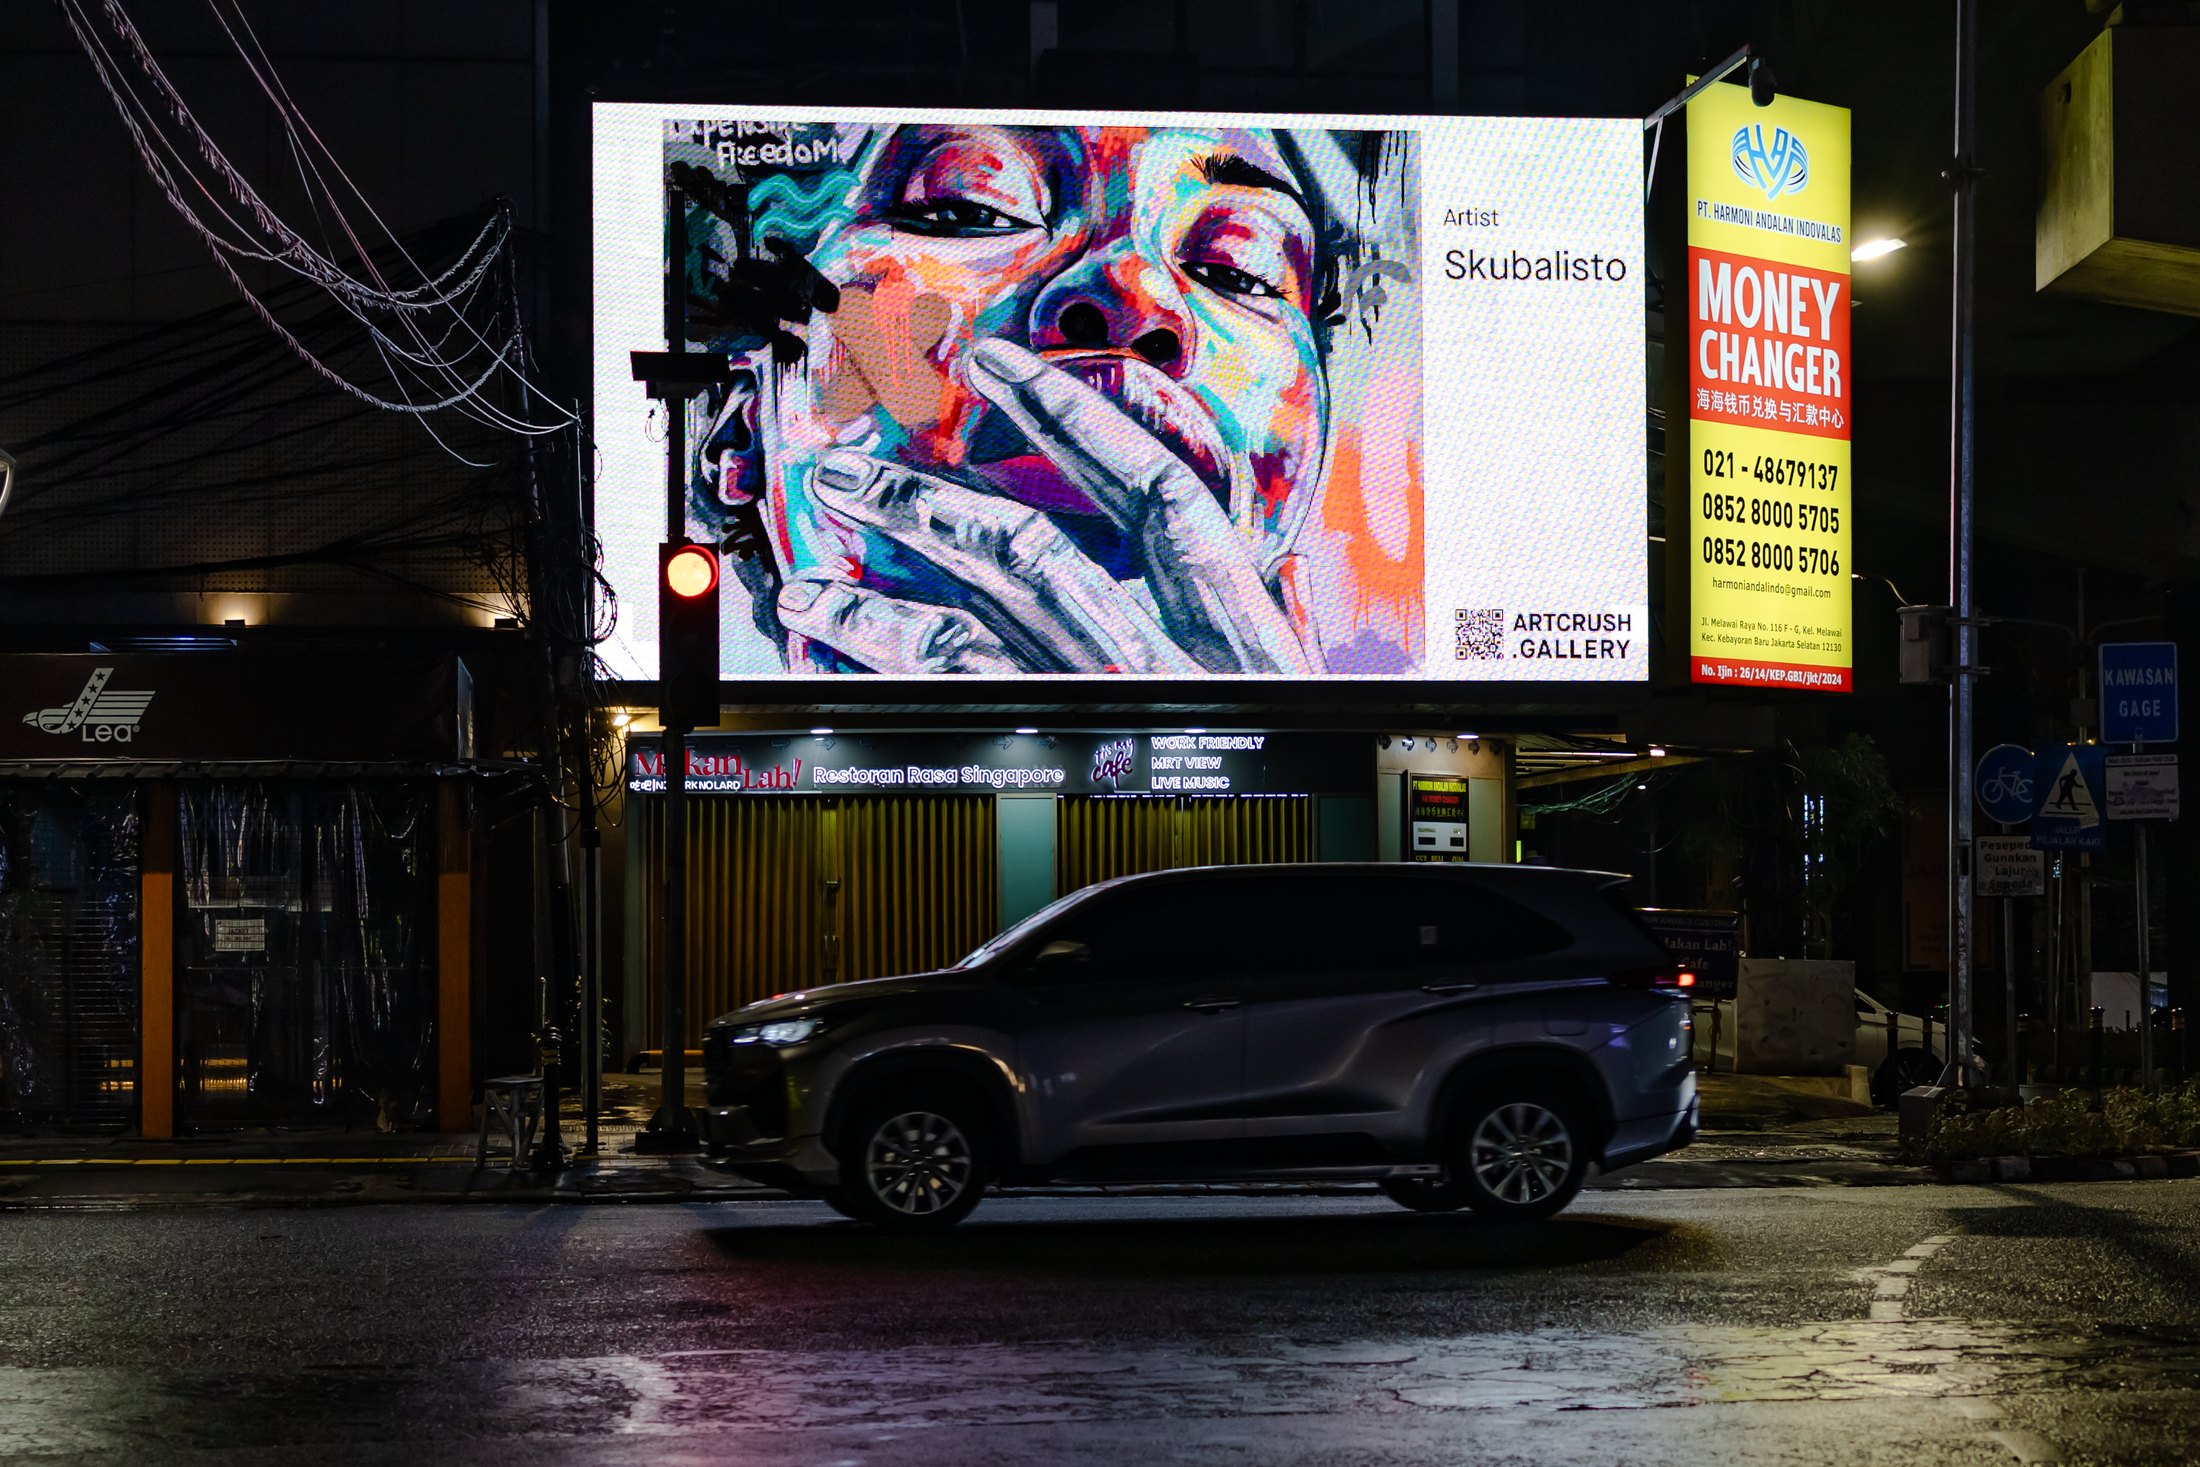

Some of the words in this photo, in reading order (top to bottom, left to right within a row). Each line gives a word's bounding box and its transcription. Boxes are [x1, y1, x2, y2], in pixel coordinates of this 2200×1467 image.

[1443, 207, 1499, 227] Artist
[1697, 200, 1711, 217] PT.
[1713, 203, 1753, 226] HARMONI
[1755, 211, 1794, 234] ANDALAN
[1796, 218, 1842, 243] INDOVALAS
[1445, 249, 1626, 281] Skubalisto
[1698, 258, 1841, 341] MONEY
[1699, 329, 1842, 398] CHANGER
[1696, 387, 1844, 429] 海海钱币兑换与汇款中心
[1704, 449, 1734, 478] 021
[1753, 456, 1838, 491] 48679137
[1703, 492, 1746, 524] 0852
[1751, 498, 1793, 528] 8000
[1799, 504, 1839, 534] 5705
[1703, 536, 1746, 567] 0852
[1751, 541, 1793, 571] 8000
[1799, 546, 1840, 576] 5706
[1712, 577, 1831, 599] harmoniandalindo@gmail.com
[1512, 613, 1631, 632] ARTCRUSH
[1711, 618, 1738, 629] Melawai
[1739, 620, 1756, 632] Raya
[1757, 622, 1769, 631] No.
[1770, 623, 1783, 632] 116
[1802, 626, 1815, 635] Kel.
[1816, 627, 1842, 638] Melawai
[1512, 639, 1630, 659] .GALLERY
[1701, 632, 1716, 643] Kec.
[1717, 634, 1753, 646] Kebayoran
[1754, 636, 1770, 646] Baru
[1771, 638, 1795, 649] Jakarta
[1796, 640, 1821, 651] Selatan
[1822, 642, 1842, 652] 12130
[1701, 664, 1716, 677] No.
[1717, 665, 1733, 680] Ijin
[1739, 667, 1842, 686] 26/14/KEP.GBI/jkt/2024
[2104, 667, 2174, 687] KAWASAN
[2119, 699, 2162, 718] GAGE
[1151, 736, 1197, 750] WORK
[1198, 736, 1265, 750] FRIENDLY
[634, 747, 743, 777] Mkan
[1151, 756, 1183, 770] MRT
[1184, 756, 1223, 770] VIEW
[743, 757, 802, 789] Lah!
[813, 766, 905, 785] Restoran
[907, 766, 958, 784] Rasa
[960, 765, 1065, 788] Singapore
[1151, 776, 1182, 790] LIVE
[1183, 776, 1231, 790] MUSIC
[700, 780, 714, 791] NO
[714, 780, 742, 791] LARD
[1984, 853, 2037, 863] Gunakan
[1995, 866, 2025, 878] Lajur
